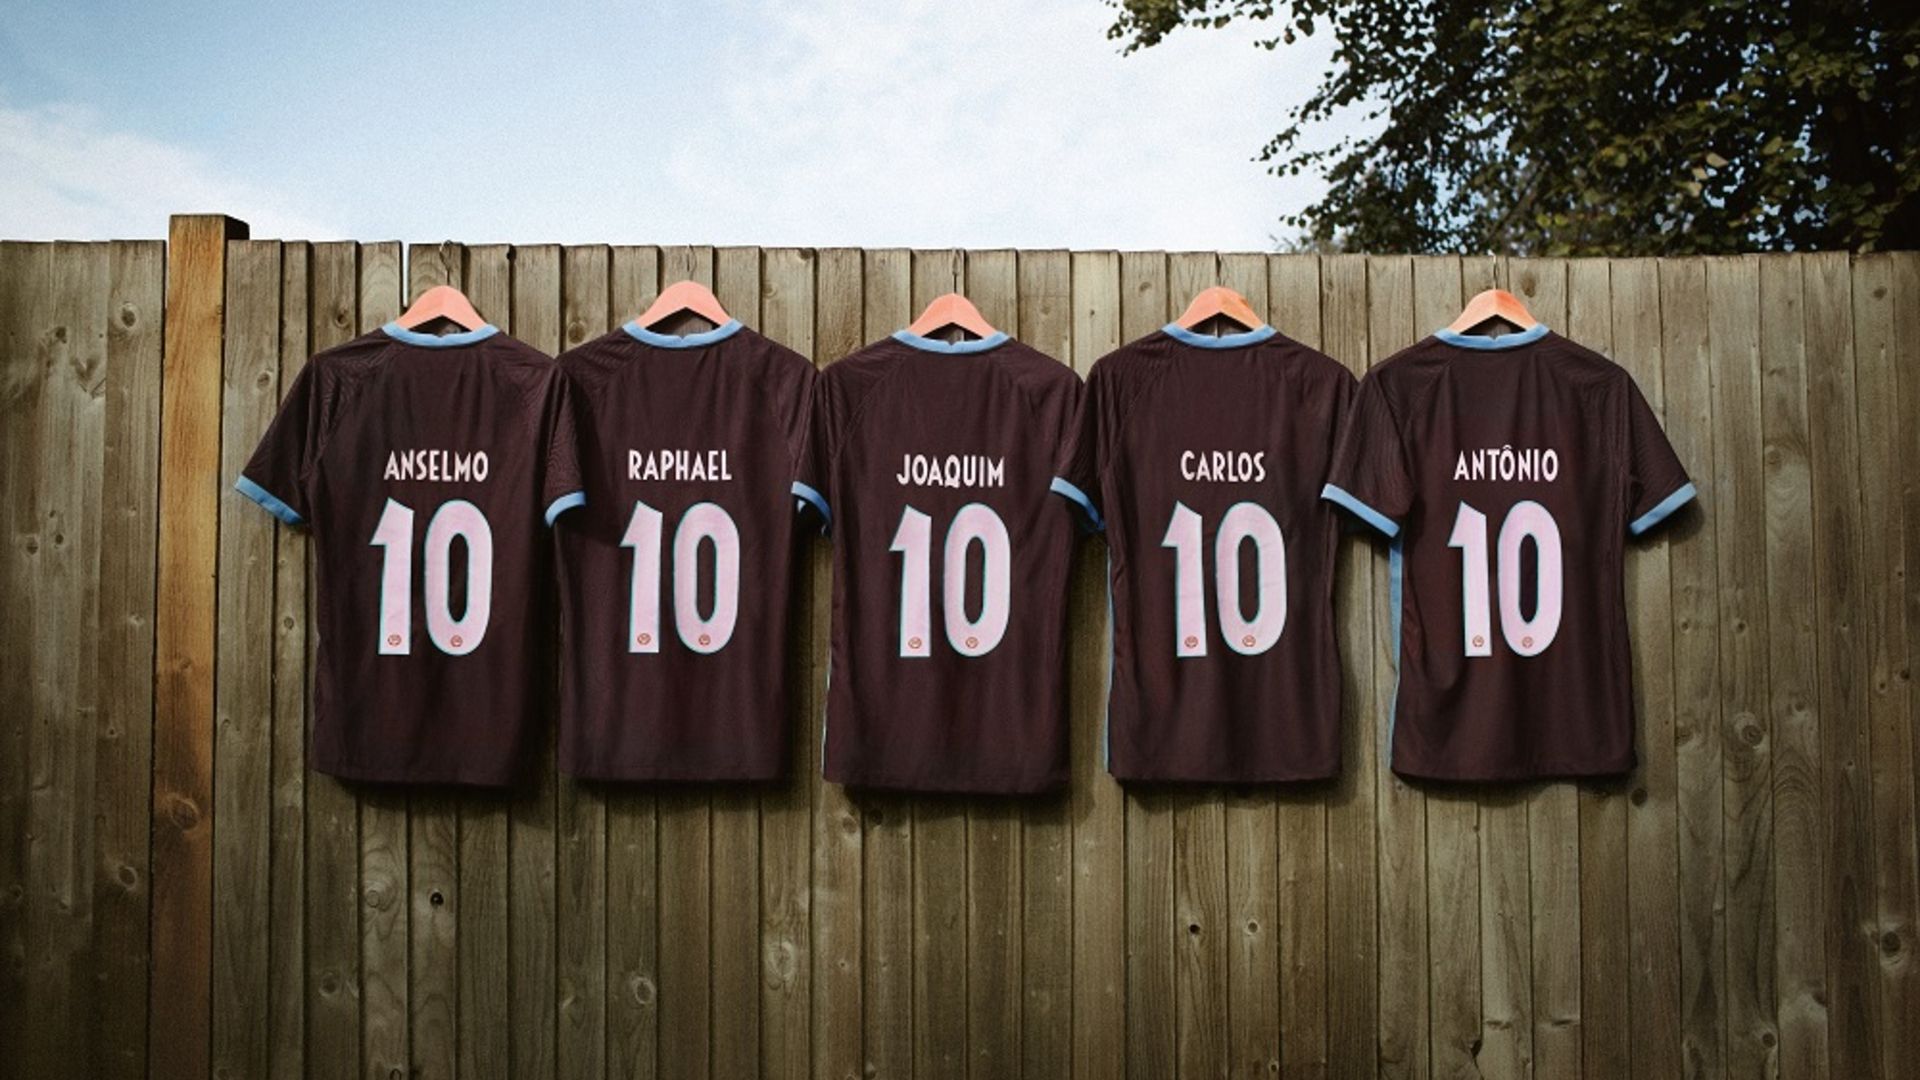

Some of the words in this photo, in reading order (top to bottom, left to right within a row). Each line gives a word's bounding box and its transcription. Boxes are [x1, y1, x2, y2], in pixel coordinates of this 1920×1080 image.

[384, 449, 489, 482] ANSELMO
[627, 449, 732, 481] RAPHAEL
[896, 453, 1005, 488] JOAQUIM
[1180, 450, 1266, 483] CARLOS
[1453, 444, 1559, 482] ANTÔNIO
[369, 497, 493, 656] 10
[620, 500, 740, 655] 10
[888, 501, 1011, 658] 10
[1161, 500, 1288, 657] 10
[1447, 500, 1563, 657] 10
